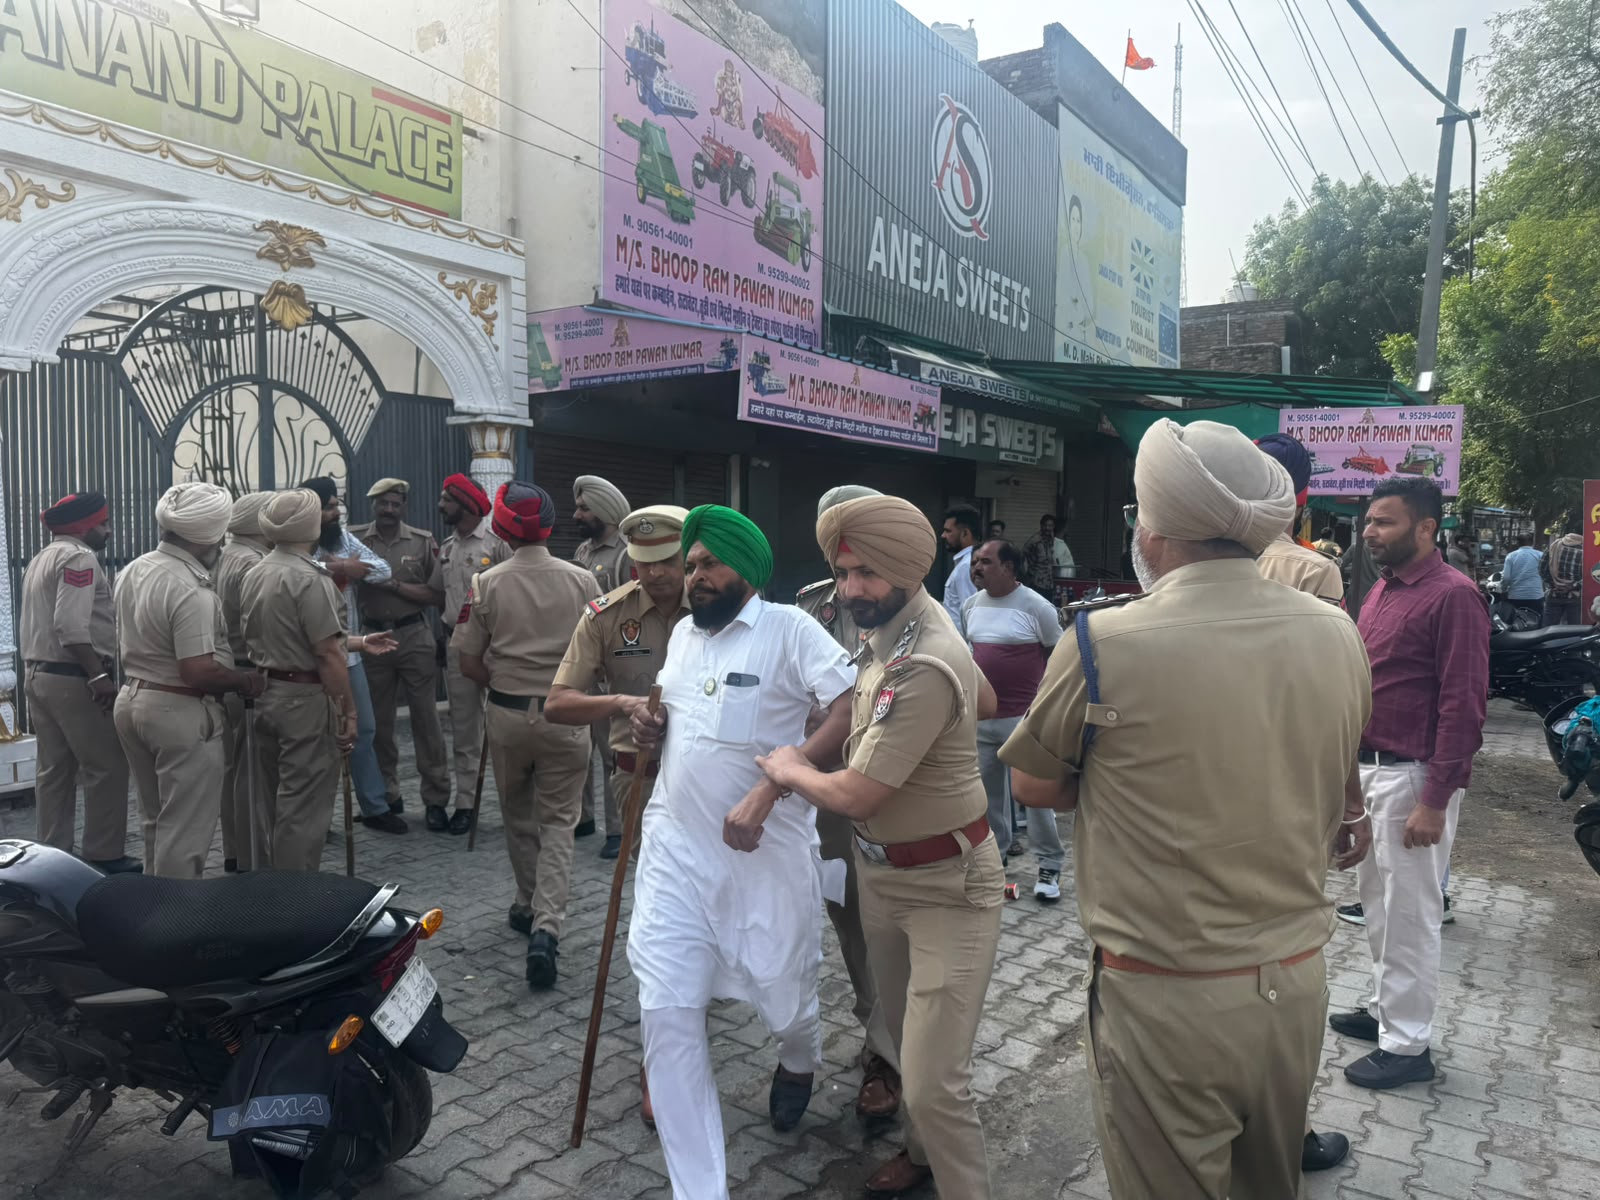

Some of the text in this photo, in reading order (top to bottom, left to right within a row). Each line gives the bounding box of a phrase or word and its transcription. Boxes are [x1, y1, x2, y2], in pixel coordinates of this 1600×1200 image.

[0, 0, 454, 194] ANAND PALACE
[623, 213, 693, 249] M. 90561-40001
[615, 234, 815, 325] M/S. BHOOP RAM PAWAN KUMAR
[767, 266, 811, 291] 95299-40002
[867, 215, 1031, 332] ANEJA SWEETS
[563, 318, 604, 331] 90561-40001
[1131, 300, 1155, 325] TOURIST
[563, 327, 604, 340] 95299-40002
[1130, 319, 1144, 338] VISA
[564, 356, 582, 375] M/S.
[584, 352, 612, 370] BHOOP
[614, 348, 633, 367] RAM
[636, 344, 668, 365] PAWAN
[670, 340, 703, 360] KUMAR
[787, 352, 820, 368] 90561-40001
[1063, 342, 1071, 358] M.
[1126, 337, 1158, 363] COUNTRIES
[928, 367, 1027, 400] ANEJA SWEETS
[787, 373, 912, 425] M/S. BHOOP RAM PAWAN KUMAR
[1287, 413, 1340, 422] M. 90561-40001
[1398, 411, 1456, 420] M. 95299-40002
[940, 403, 1057, 459] EJA SWEETS
[1309, 425, 1344, 443] BHOOP
[1347, 425, 1370, 443] RAM
[1372, 424, 1411, 443] PAWAN
[1413, 424, 1453, 443] KUMAR
[239, 1096, 324, 1127] AMA
